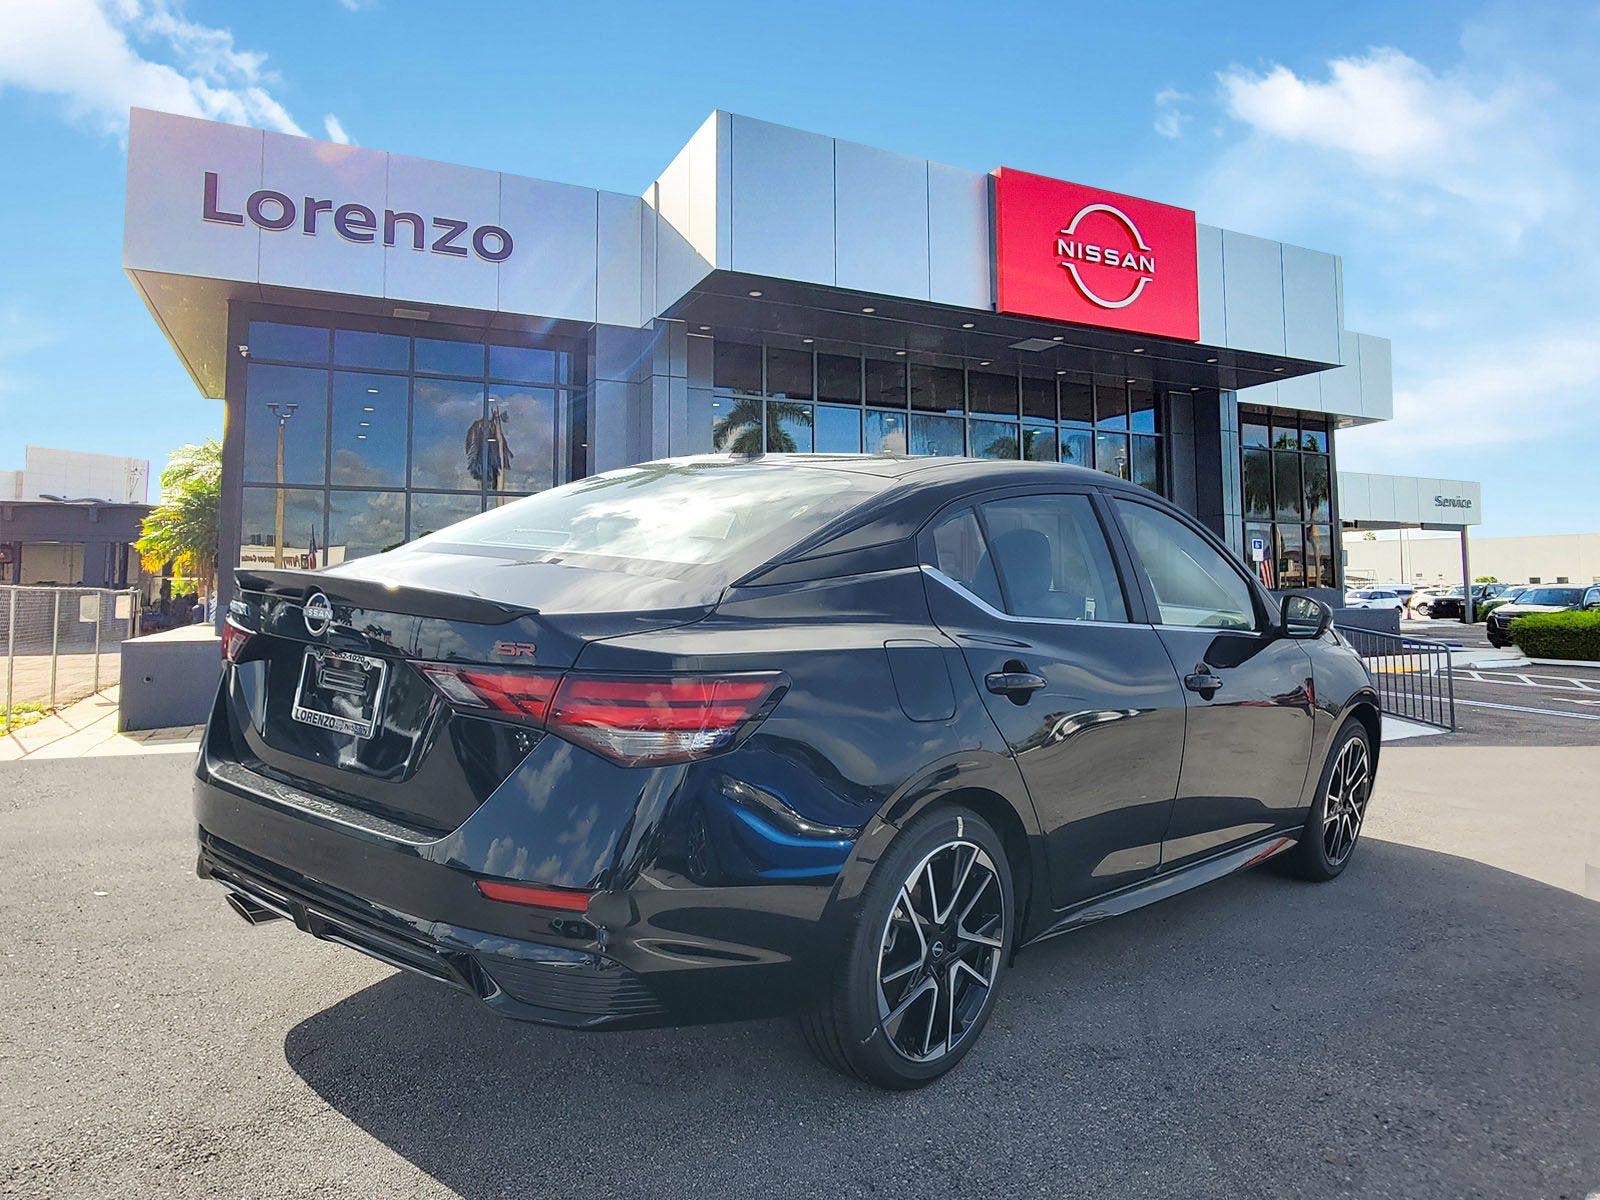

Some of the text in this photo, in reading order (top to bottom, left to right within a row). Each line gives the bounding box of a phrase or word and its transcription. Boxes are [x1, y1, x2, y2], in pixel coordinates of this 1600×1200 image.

[203, 171, 514, 262] Lorenzo
[1057, 238, 1155, 273] NISSAN
[1434, 495, 1472, 509] Service
[497, 641, 536, 656] SR
[295, 708, 336, 729] LORENZO
